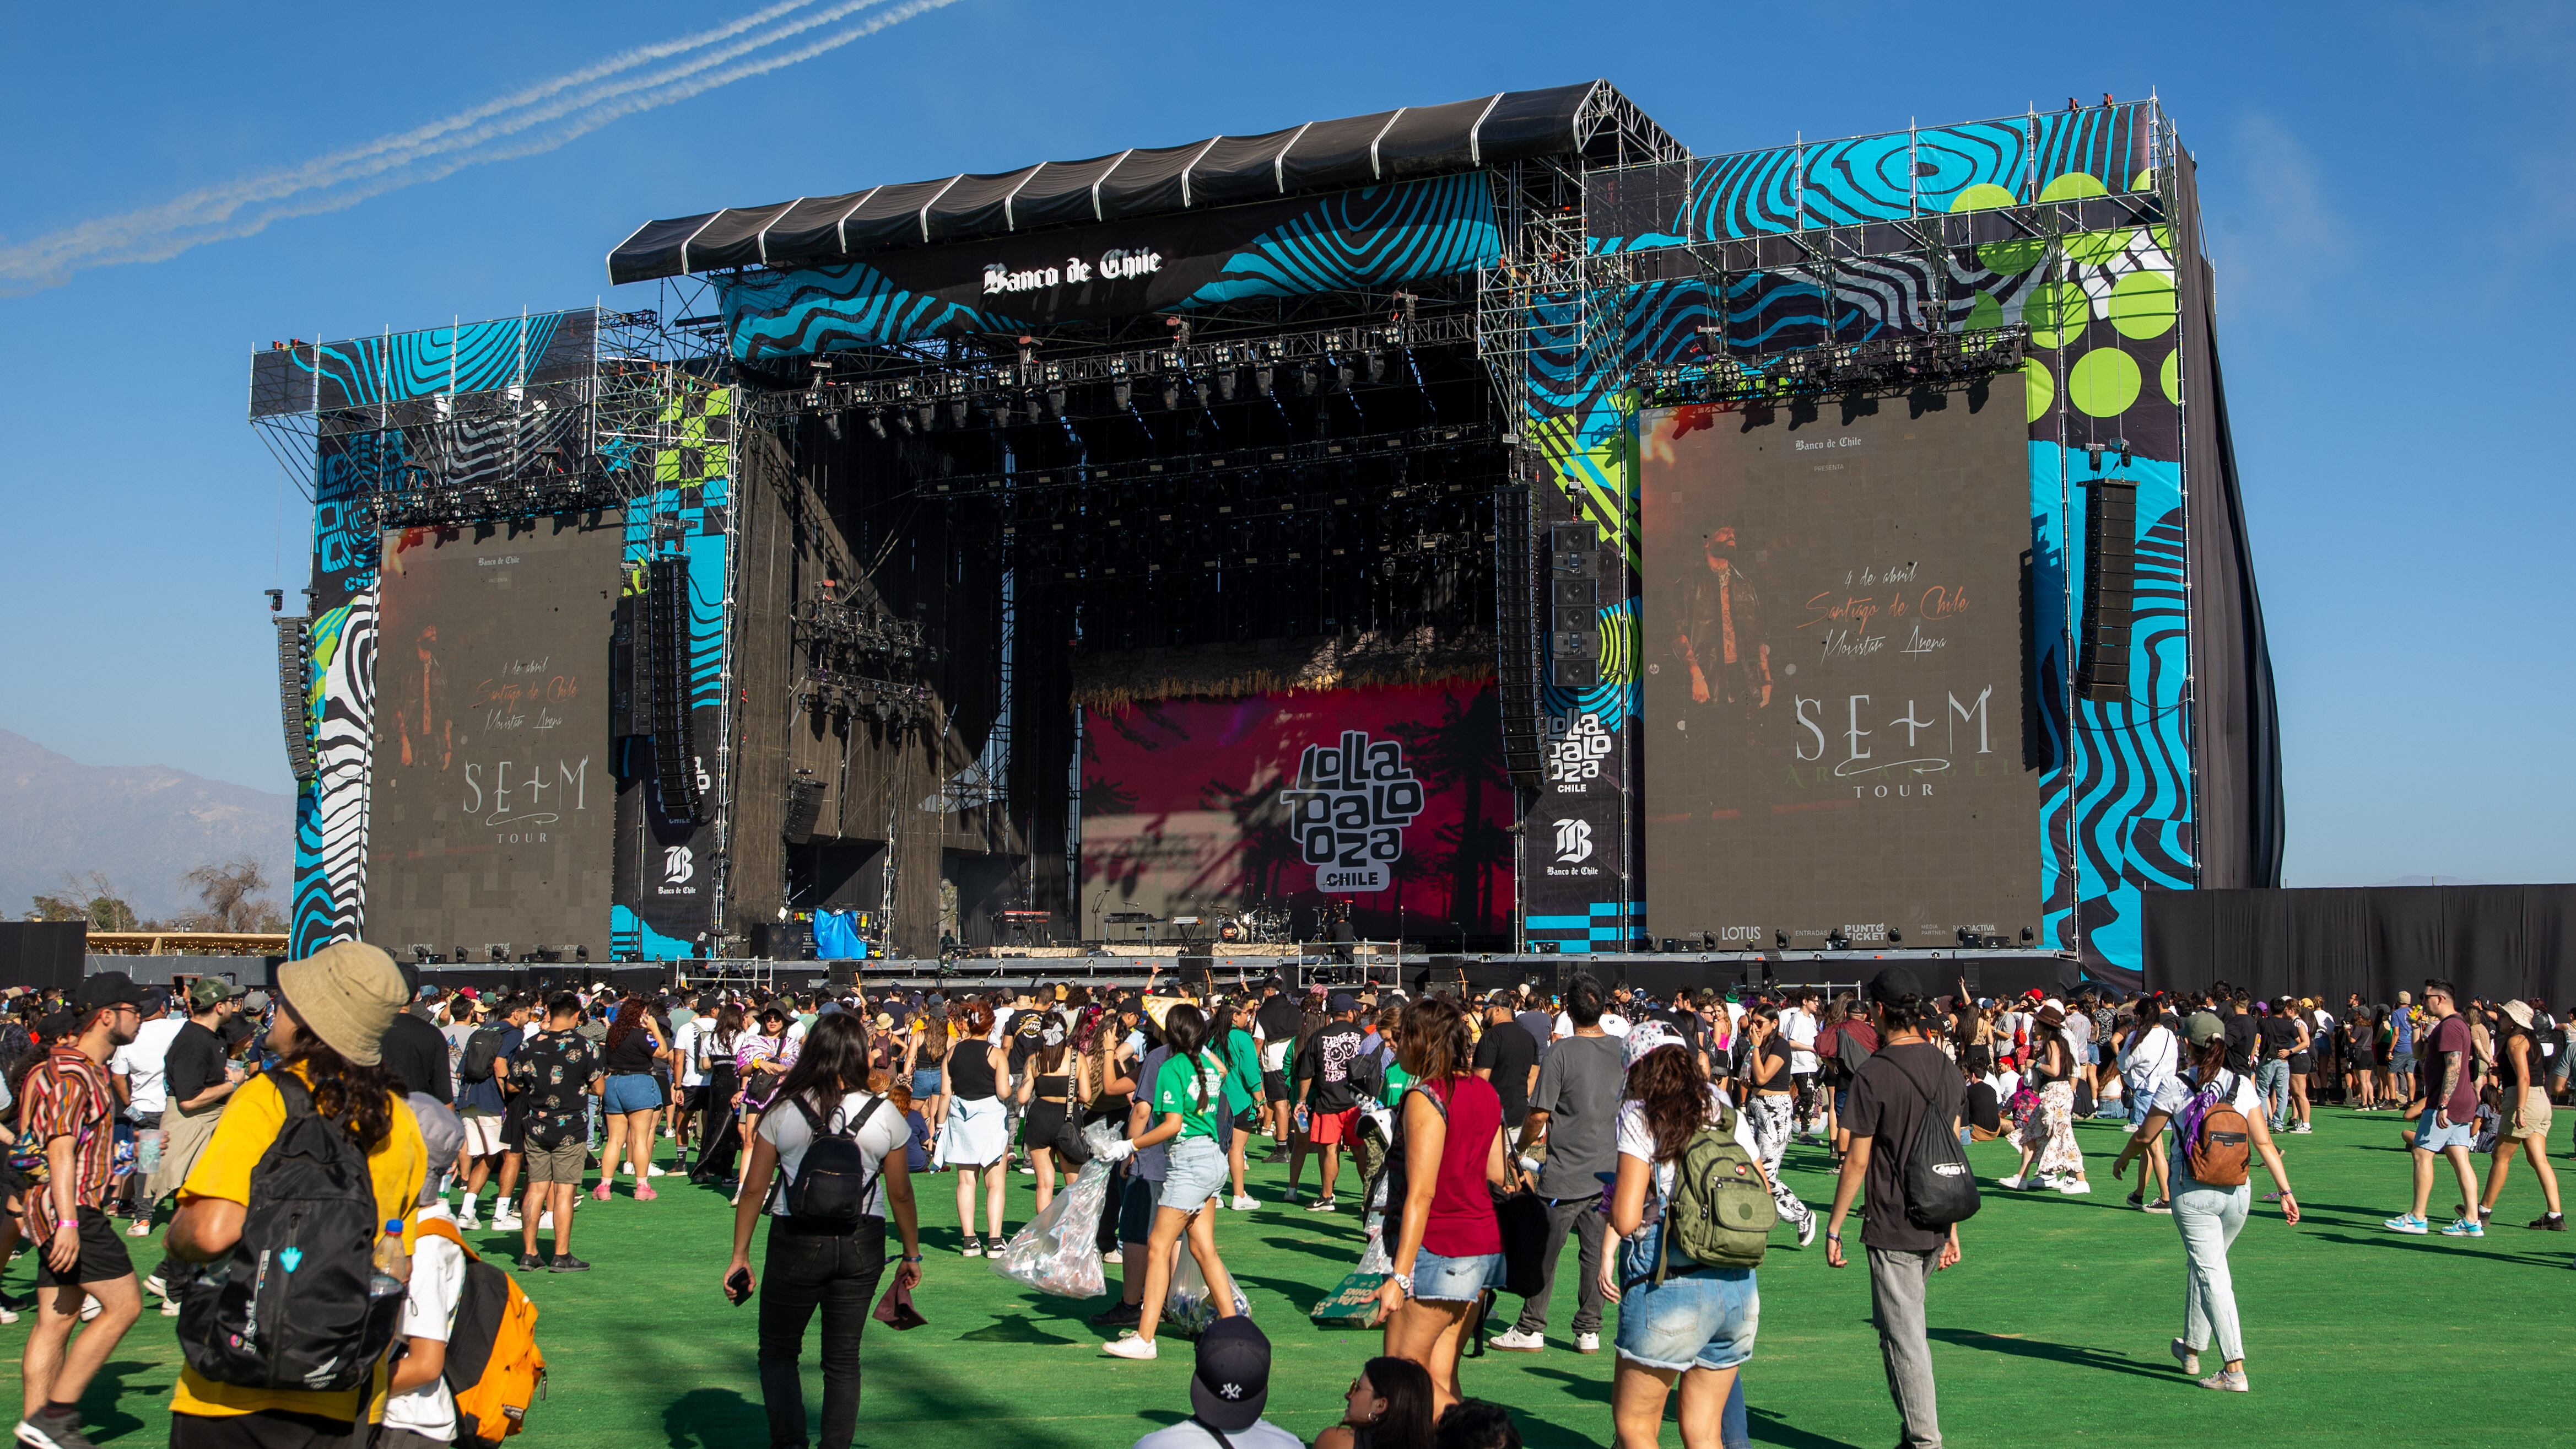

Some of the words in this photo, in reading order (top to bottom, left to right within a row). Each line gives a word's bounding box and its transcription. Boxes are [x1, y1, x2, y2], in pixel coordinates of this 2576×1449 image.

[983, 262, 1059, 295] Banco
[1067, 257, 1092, 283] de
[1100, 246, 1162, 280] Chile
[1795, 440, 1823, 450] Banco
[1827, 439, 1835, 448] de
[1839, 437, 1861, 447] Chile
[478, 557, 496, 565] Banco
[506, 556, 520, 564] Chile
[1844, 570, 1852, 590] 4
[1860, 567, 1876, 586] de
[1883, 562, 1918, 583] abril
[1796, 591, 1880, 634] Santiago
[1888, 592, 1907, 617] de
[1920, 585, 1969, 621] Chile
[1900, 625, 1947, 661] Arena
[511, 660, 524, 675] de
[525, 656, 548, 674] abril
[469, 678, 522, 713] Santiago
[527, 681, 541, 701] de
[548, 676, 577, 703] Chile
[533, 707, 563, 736] Arena
[1557, 784, 1587, 793] CHILE
[1853, 784, 1934, 798] TOUR
[497, 832, 547, 844] TOUR
[1547, 866, 1569, 875] Banco
[1581, 866, 1598, 875] Chile
[1326, 872, 1378, 887] CHILE
[1721, 926, 1761, 940] LOTUS
[1844, 923, 1884, 933] PUNTO
[1845, 932, 1886, 941] TICKET
